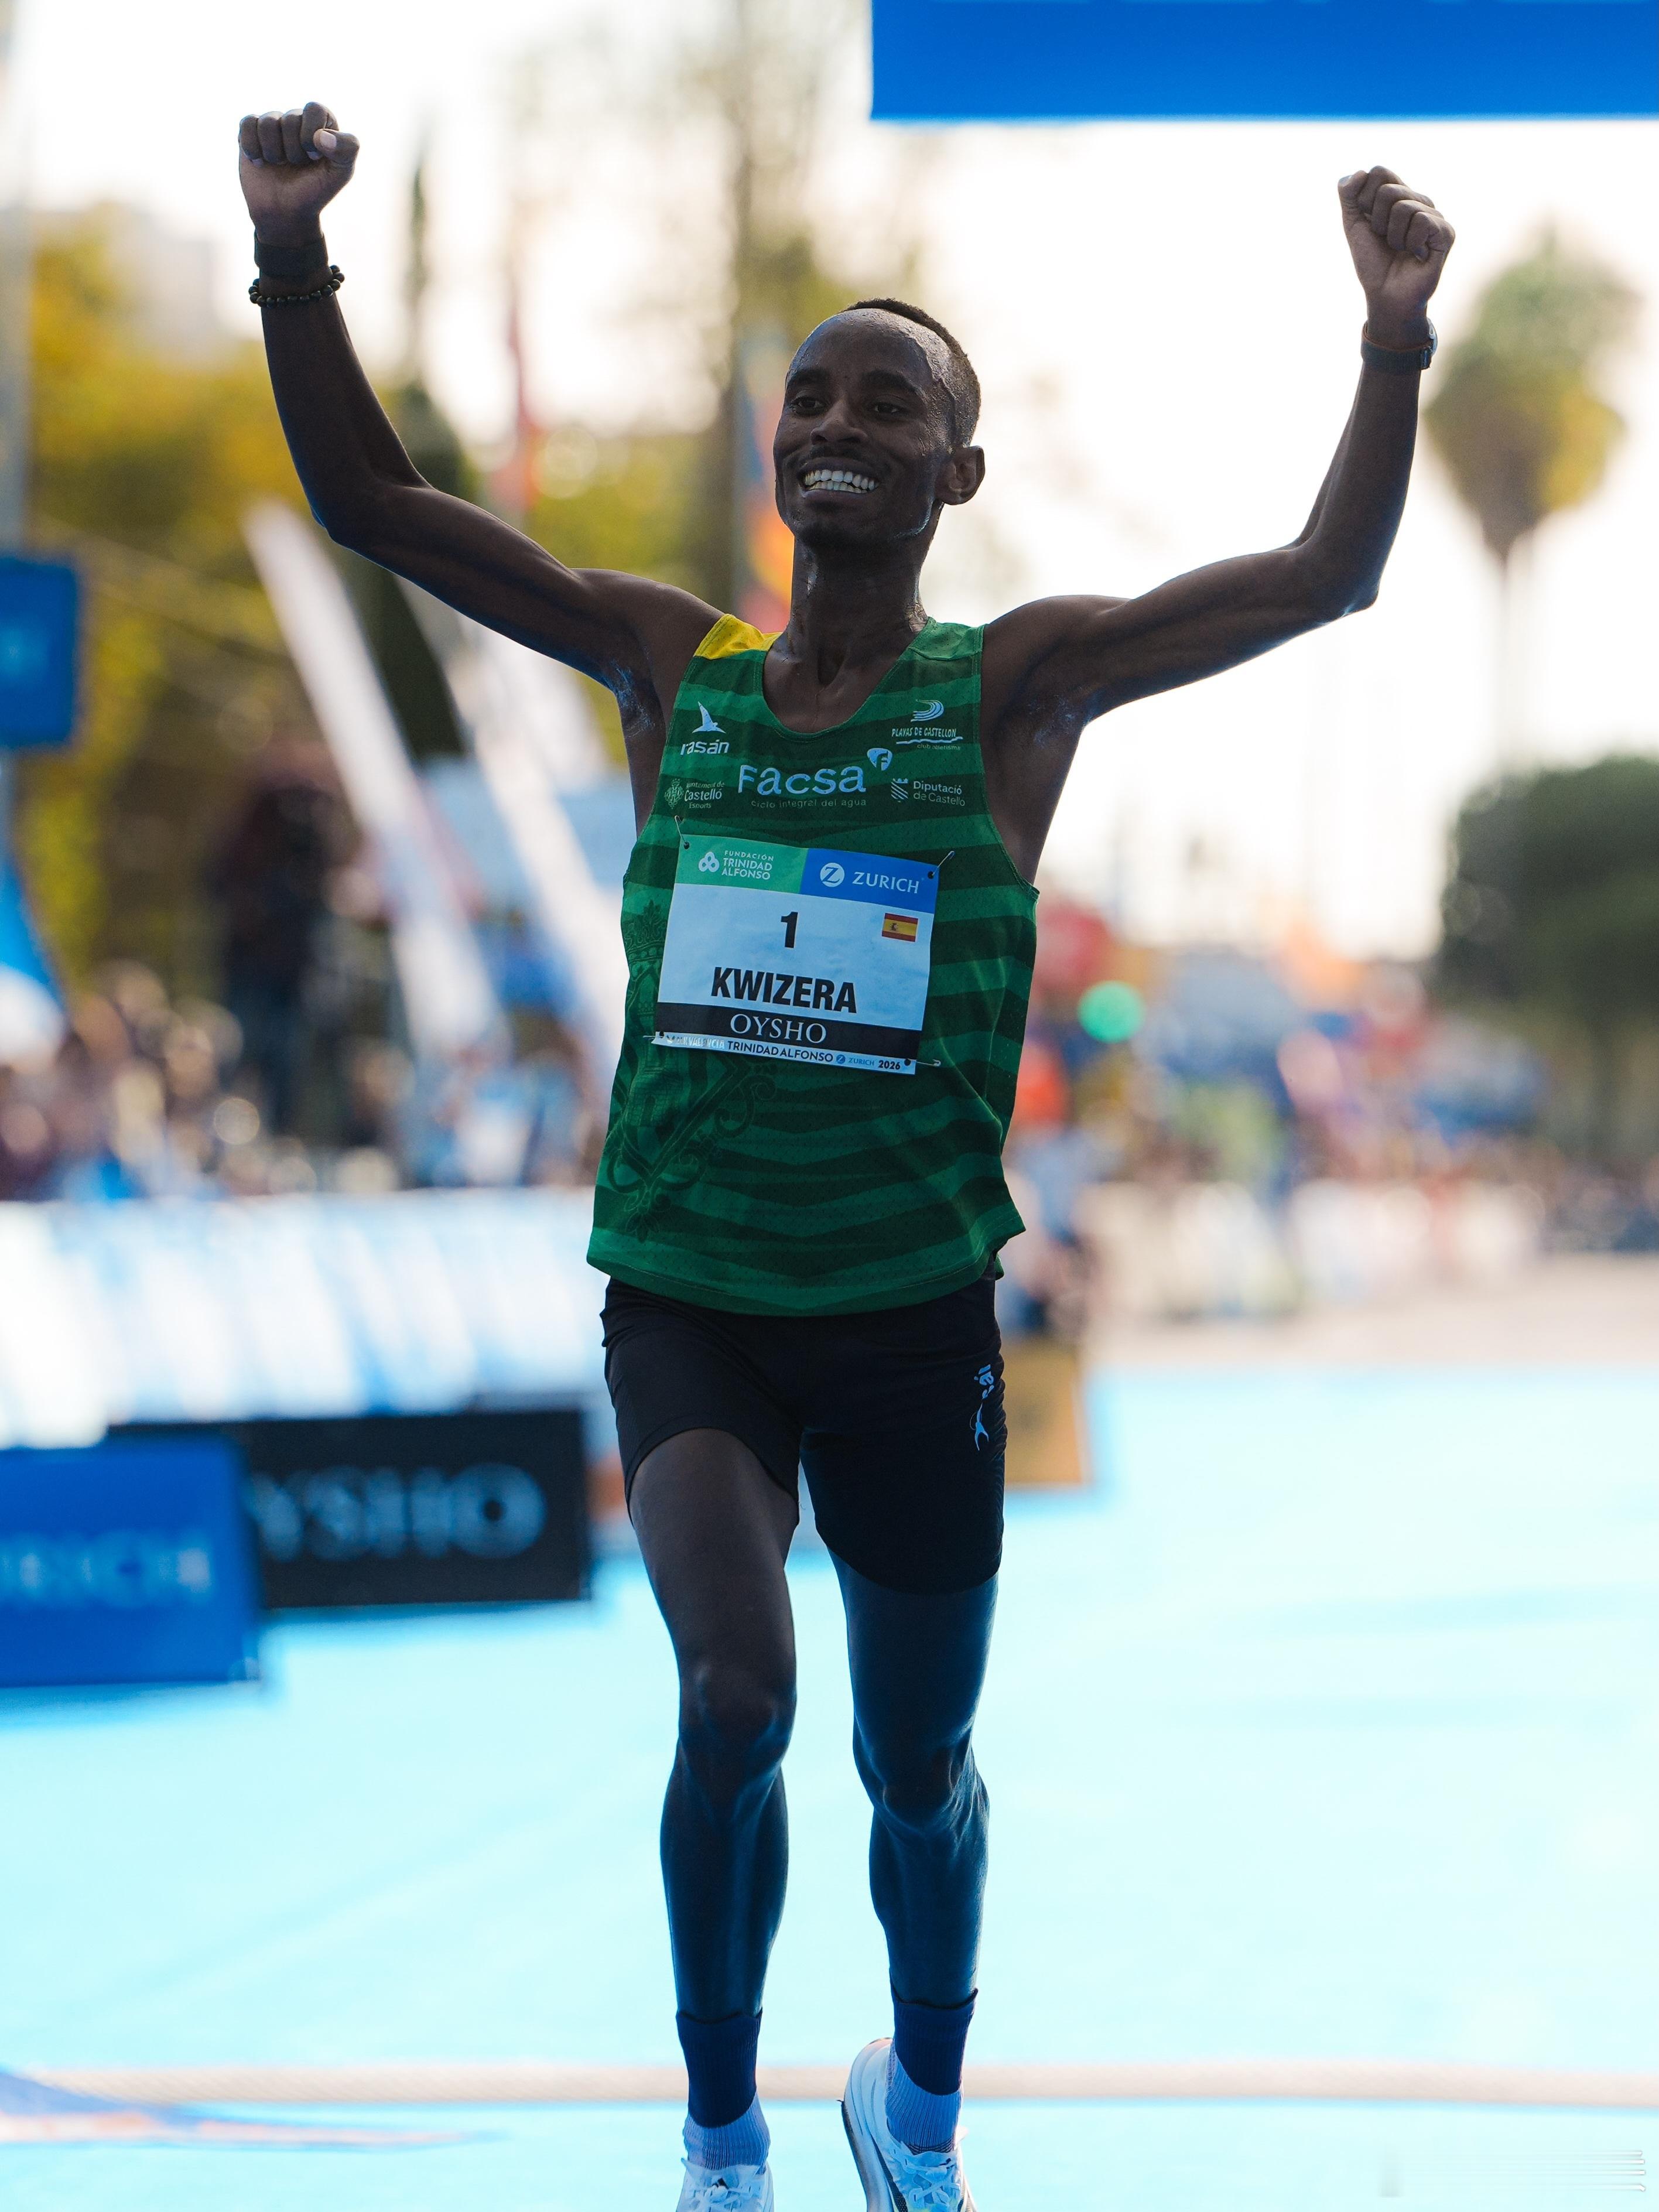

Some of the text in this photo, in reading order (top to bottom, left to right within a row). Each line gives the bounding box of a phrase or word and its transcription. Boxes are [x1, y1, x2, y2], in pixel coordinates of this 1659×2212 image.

[891, 727, 913, 737] PLAYAS
[914, 727, 922, 736] DE
[680, 739, 730, 755] rasán
[738, 764, 867, 795] Facsa
[684, 788, 722, 802] Castelló
[914, 781, 962, 795] Diputació
[914, 791, 926, 801] de
[751, 800, 776, 808] ciclo
[779, 799, 817, 808] integral
[842, 799, 867, 809] agua
[724, 850, 774, 861] FUNDACIÓN
[723, 857, 772, 871] TRINIDAD
[721, 867, 771, 880] ALFONSO
[852, 871, 919, 894] ZURICH
[780, 911, 798, 948] 1
[710, 966, 857, 1014] KWIZERA
[730, 1013, 826, 1044] OYSHO
[727, 1040, 779, 1055] TRINIDAD
[779, 1047, 833, 1062] ALFONSO
[849, 1058, 875, 1066] ZURICH
[878, 1059, 901, 1070] 2026
